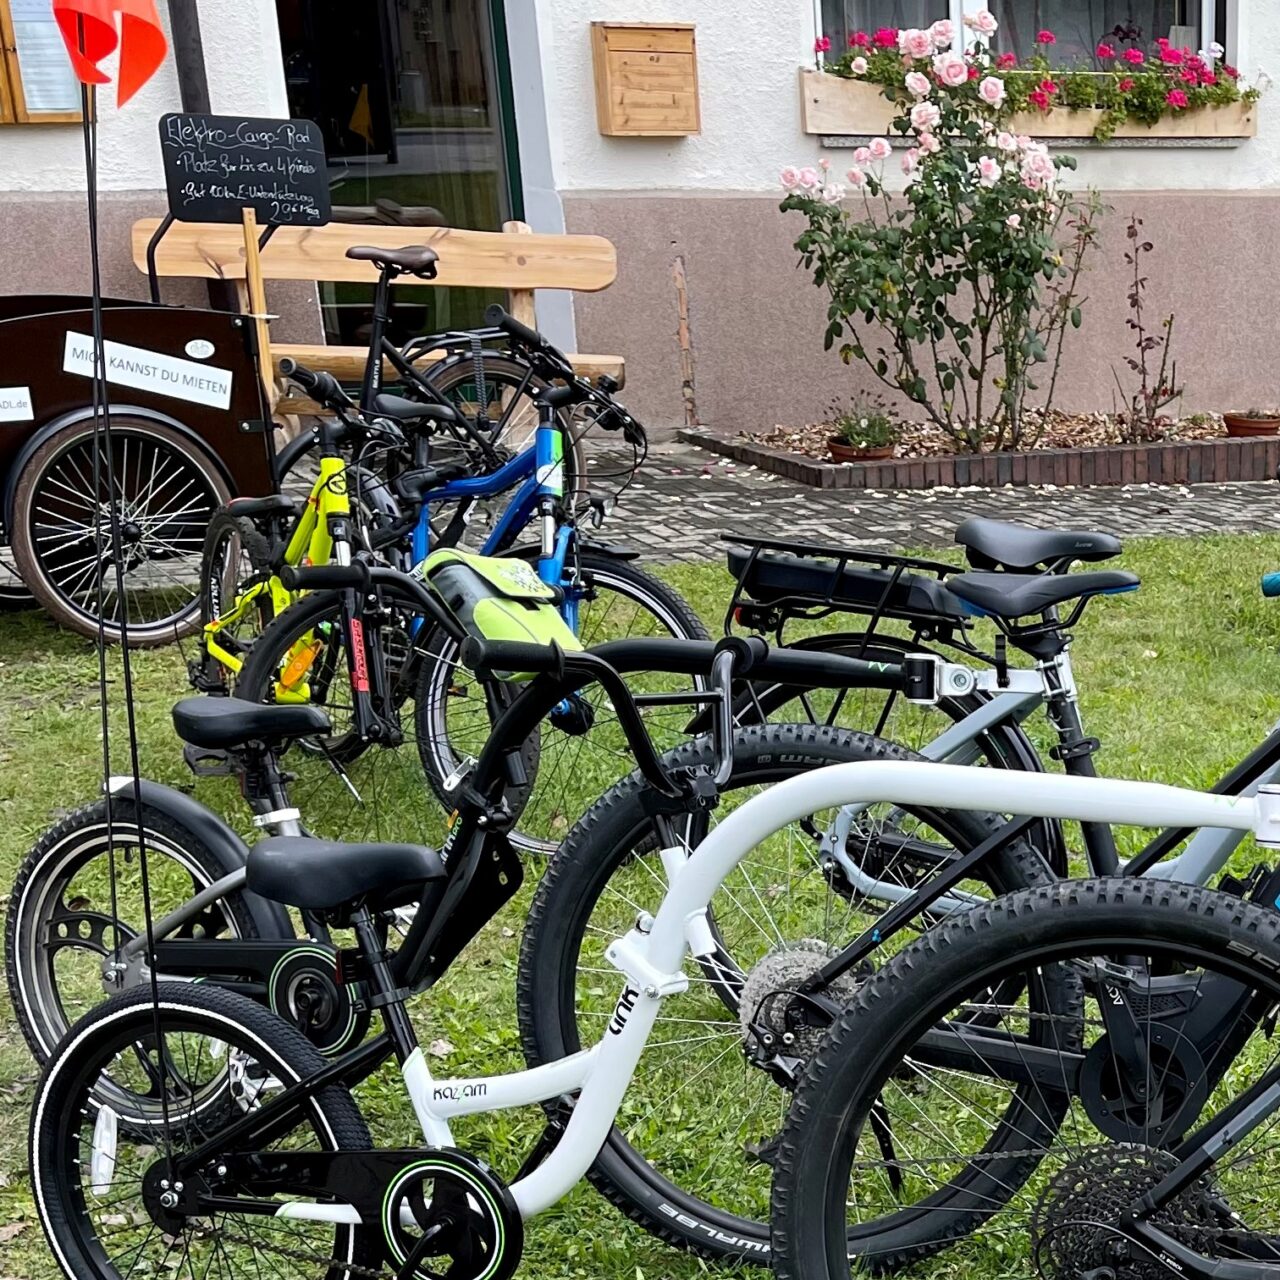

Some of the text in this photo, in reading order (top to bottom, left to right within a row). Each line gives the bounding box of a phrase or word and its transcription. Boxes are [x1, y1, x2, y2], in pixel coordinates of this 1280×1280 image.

[72, 347, 228, 395] MIC KANNST DU MIETEN
